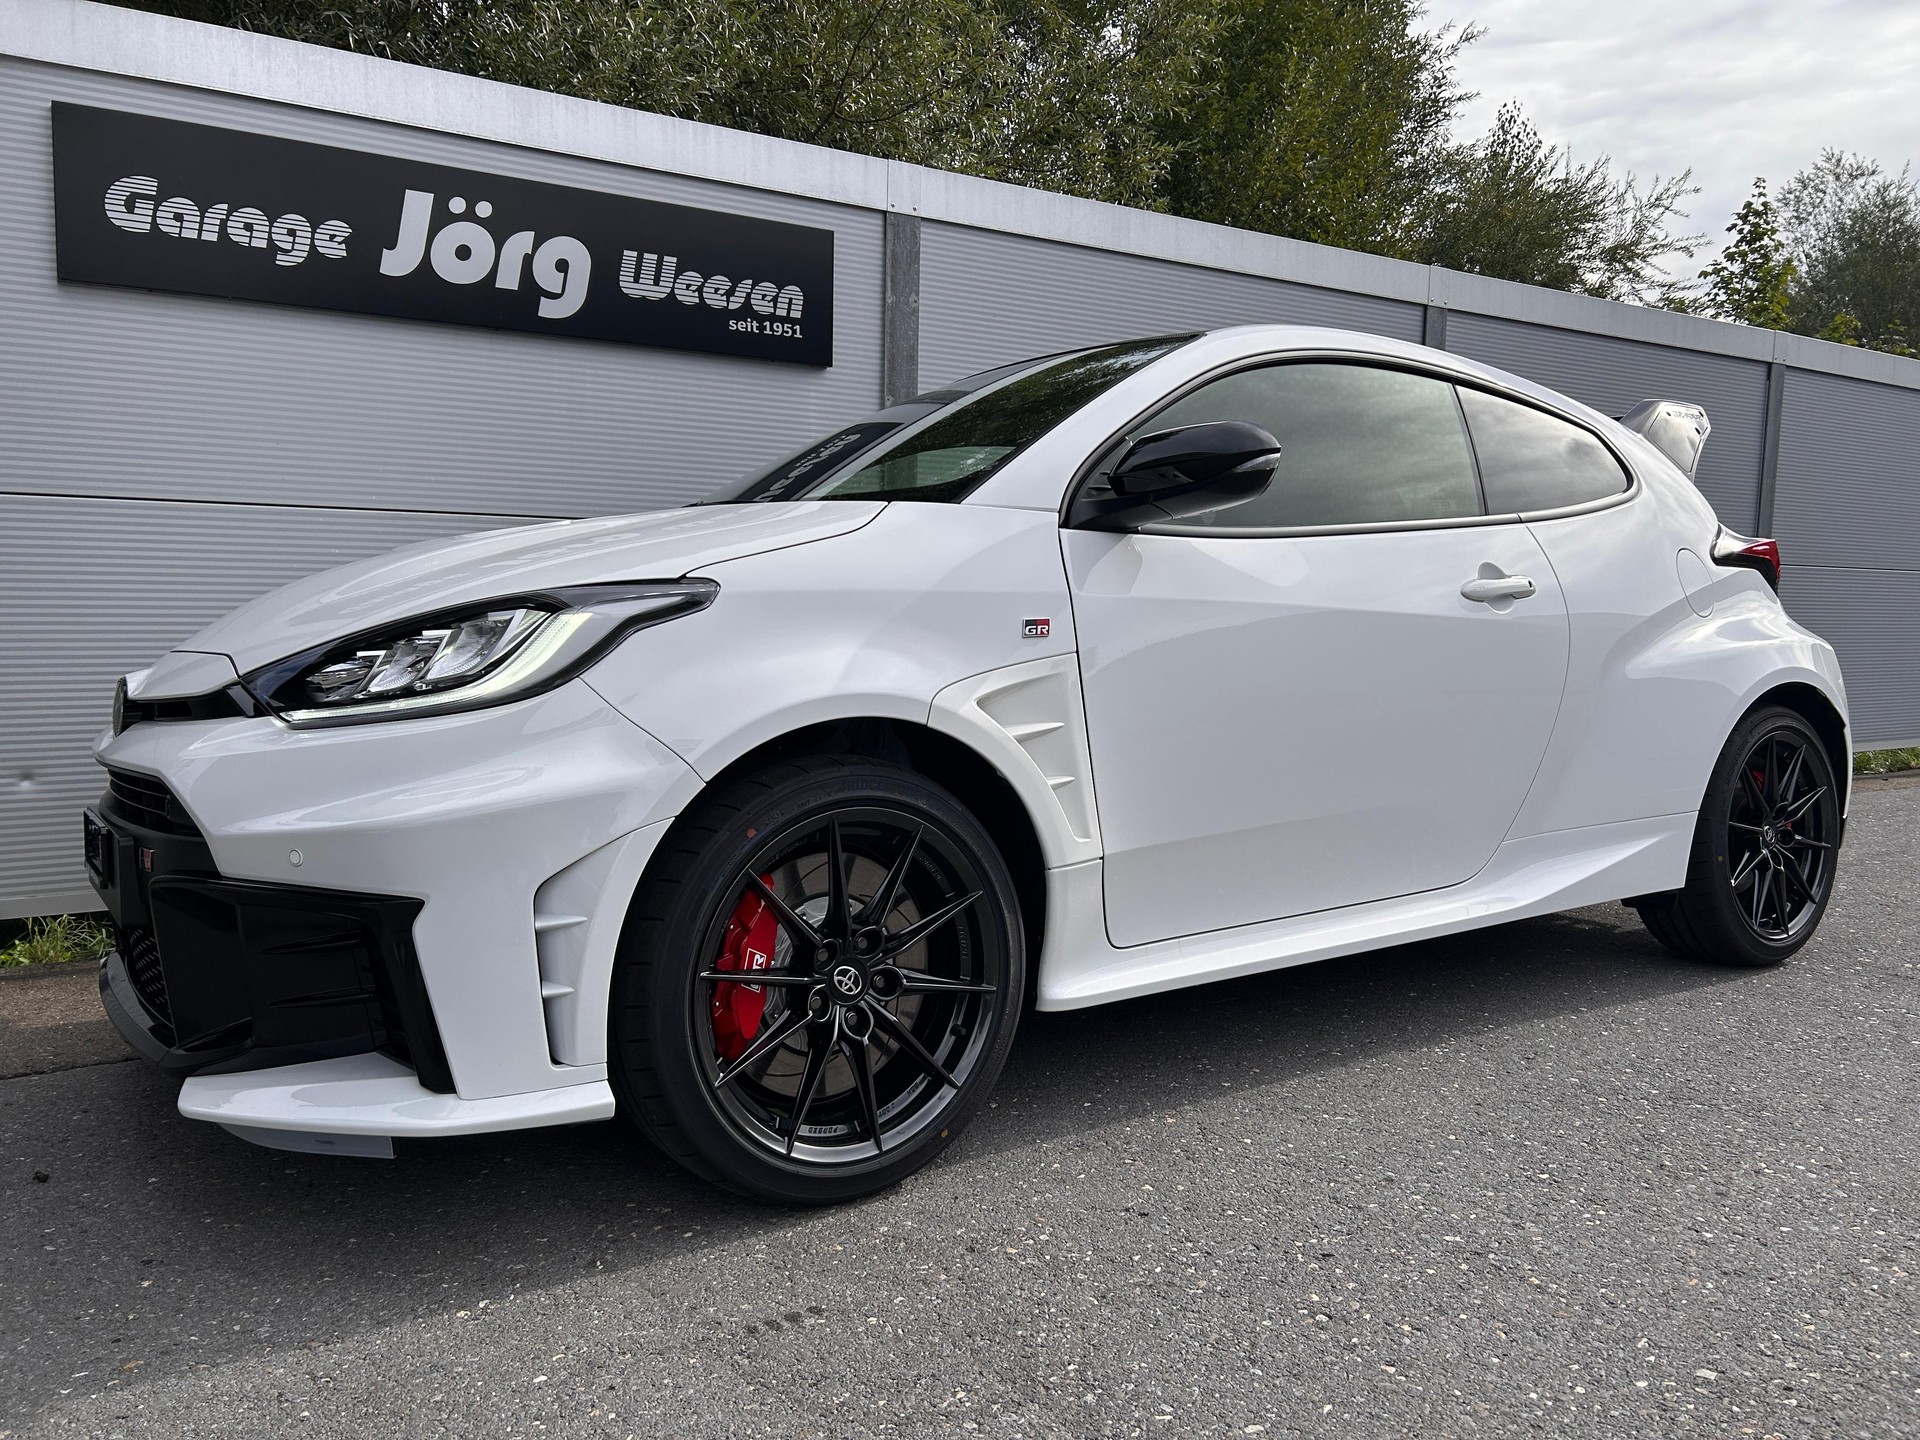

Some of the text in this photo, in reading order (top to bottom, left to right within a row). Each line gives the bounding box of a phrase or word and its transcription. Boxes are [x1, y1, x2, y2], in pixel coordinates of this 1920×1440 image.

[104, 175, 804, 319] Garage Jörg Weesen
[729, 318, 803, 338] seit 1951
[1025, 625, 1049, 635] GR
